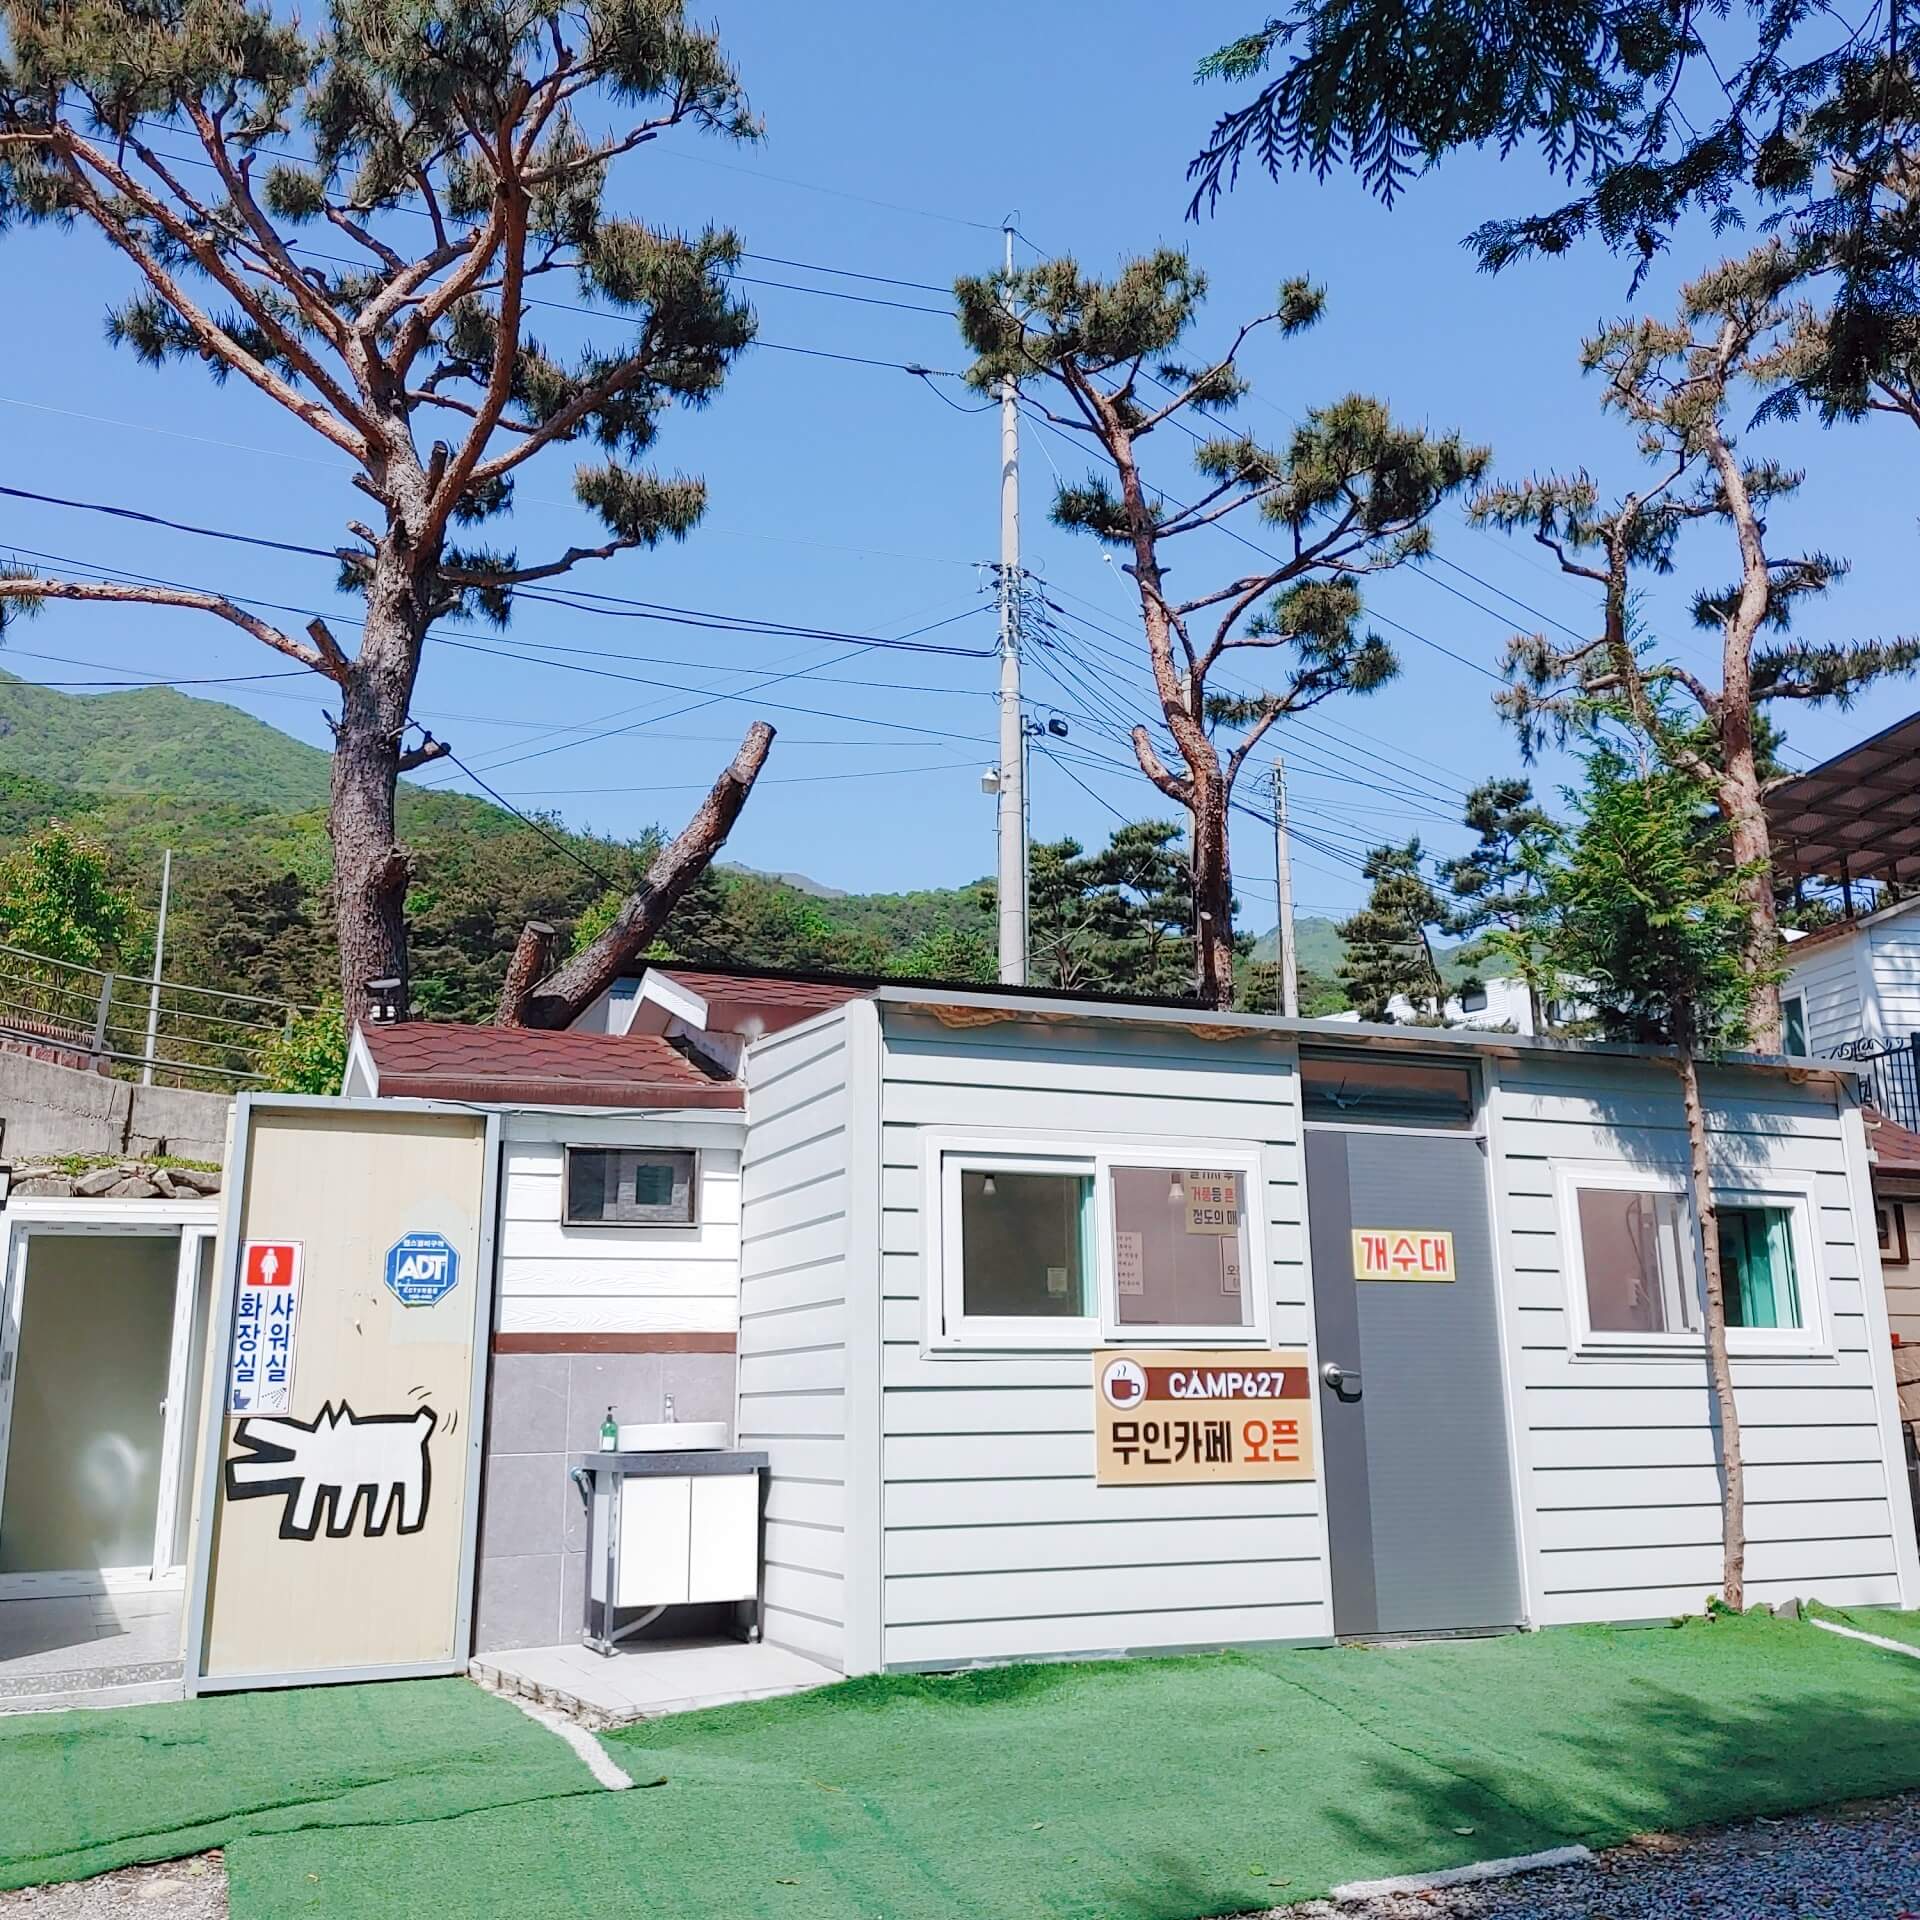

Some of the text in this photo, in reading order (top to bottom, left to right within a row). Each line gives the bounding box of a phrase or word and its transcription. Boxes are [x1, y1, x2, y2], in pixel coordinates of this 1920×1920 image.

[1193, 1208, 1225, 1225] 정도의
[398, 1254, 448, 1281] ADT
[1360, 1236, 1448, 1272] 개수대
[233, 1292, 263, 1383] 화장실
[265, 1292, 295, 1383] 샤워실
[1168, 1369, 1285, 1399] CAMP627
[1112, 1419, 1300, 1465] 무인카페 오픈
